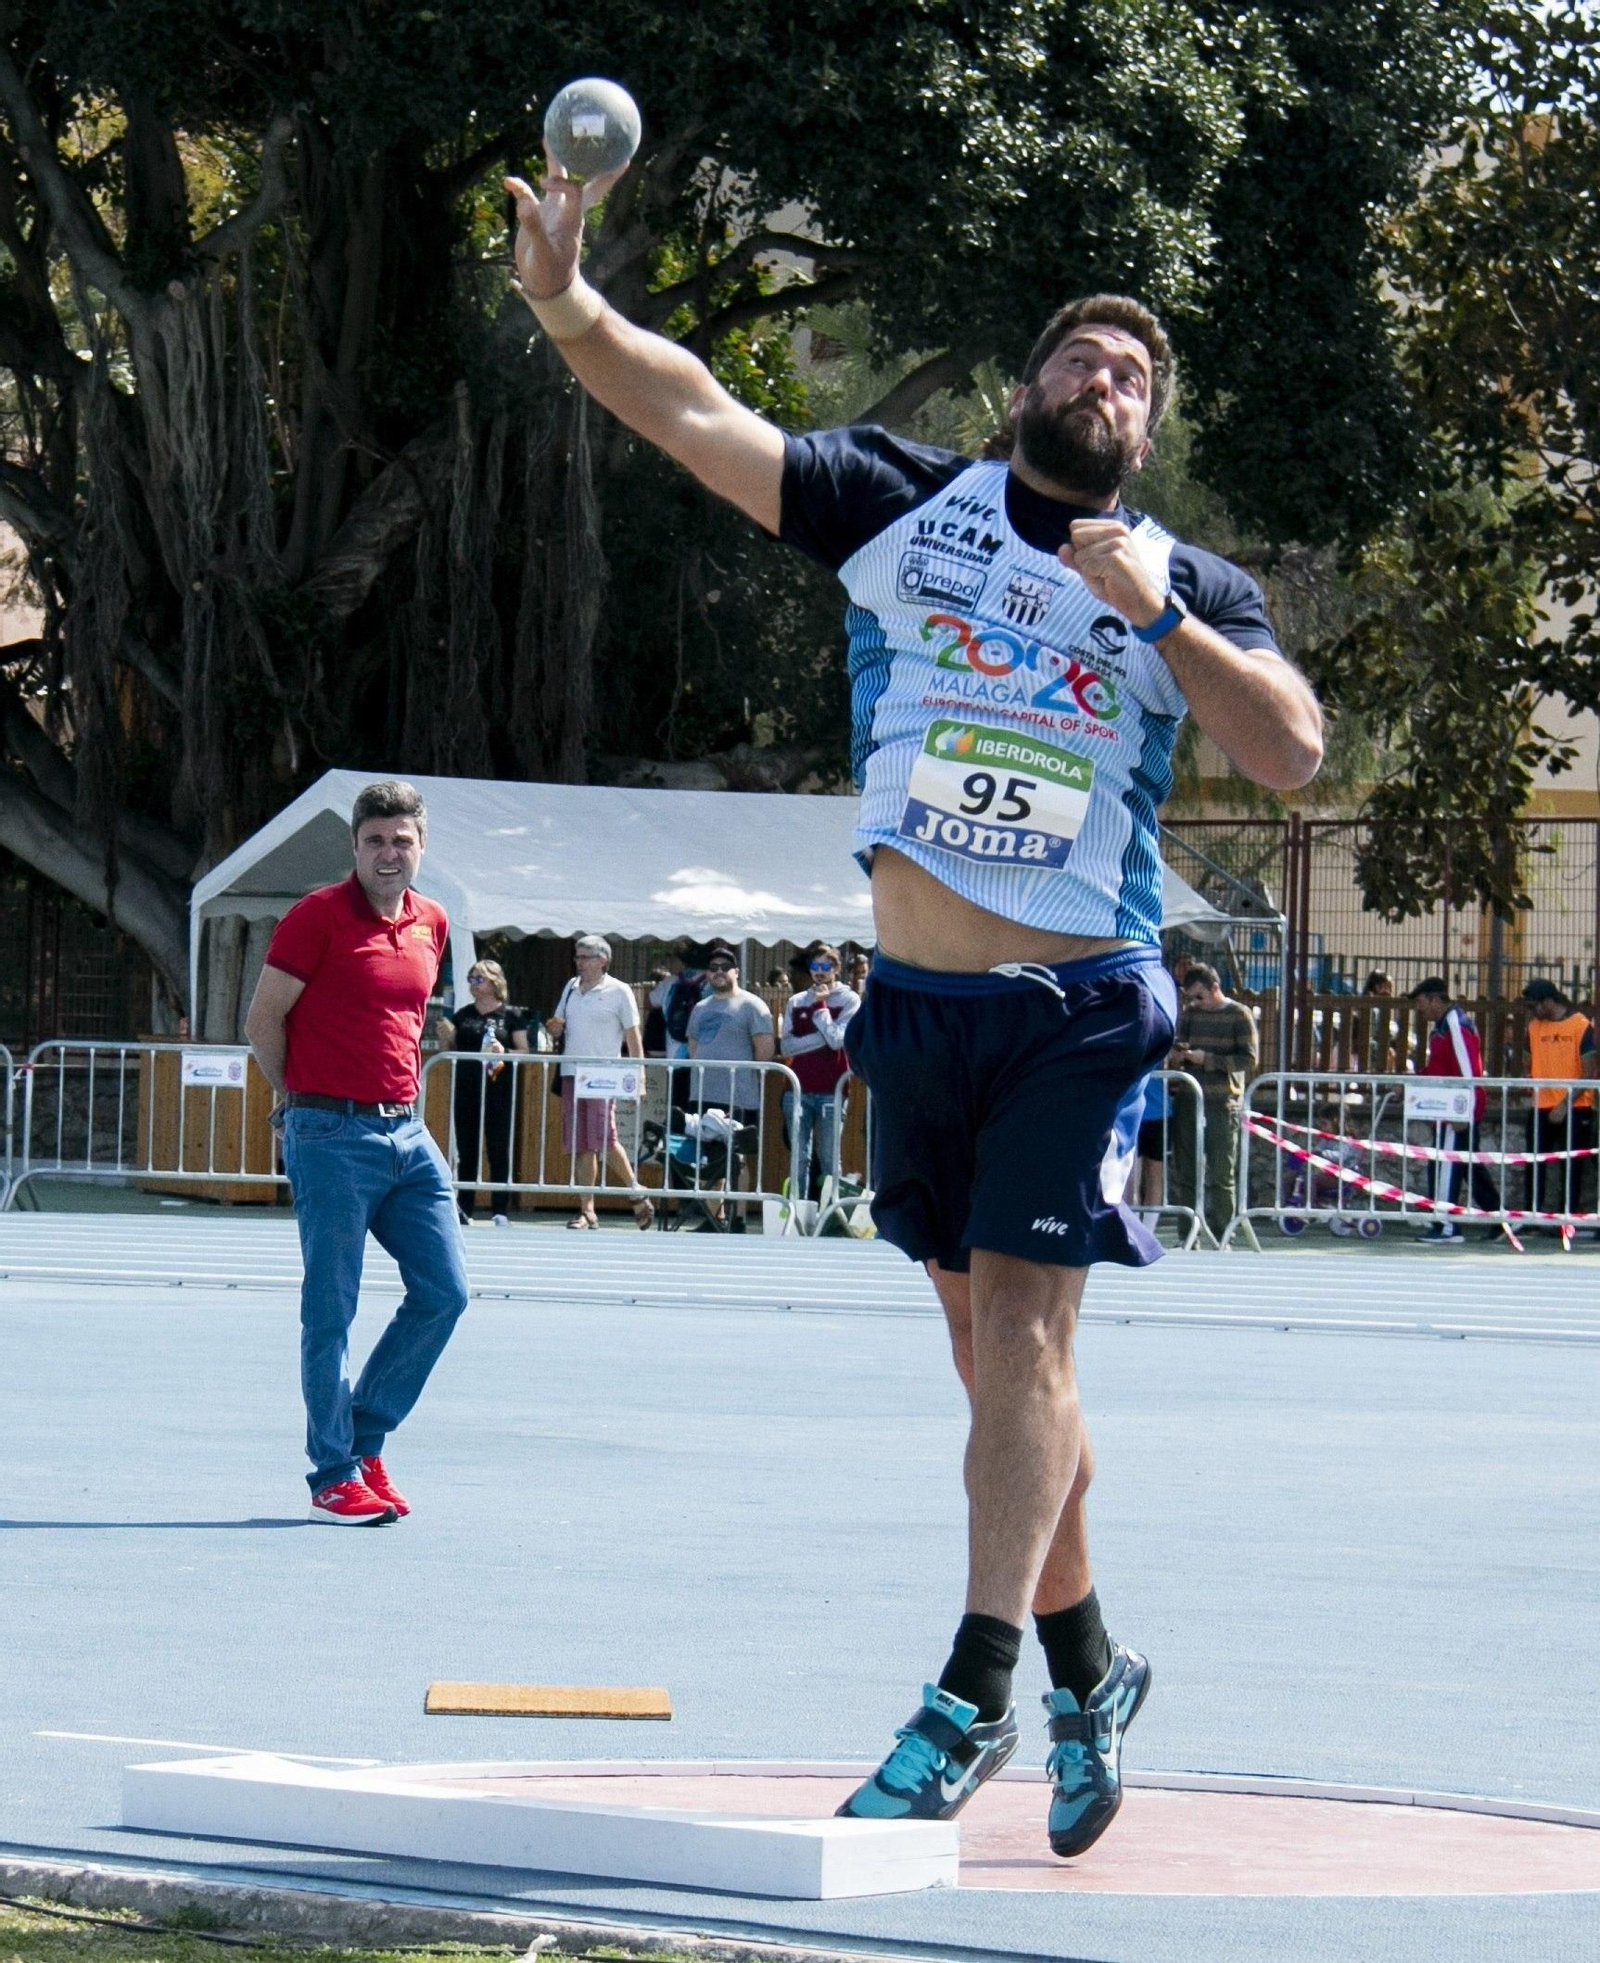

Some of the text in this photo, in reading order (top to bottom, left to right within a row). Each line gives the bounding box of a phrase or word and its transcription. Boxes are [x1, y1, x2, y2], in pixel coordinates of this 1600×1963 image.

[910, 535, 993, 566] UNIVERSIDAD
[918, 520, 1004, 556] UCAM
[928, 673, 1028, 706] MALAGA
[1060, 718, 1081, 731] OF
[1085, 724, 1119, 741] SPORT
[976, 738, 1083, 781] IBERDROLA
[958, 772, 1037, 822] 95
